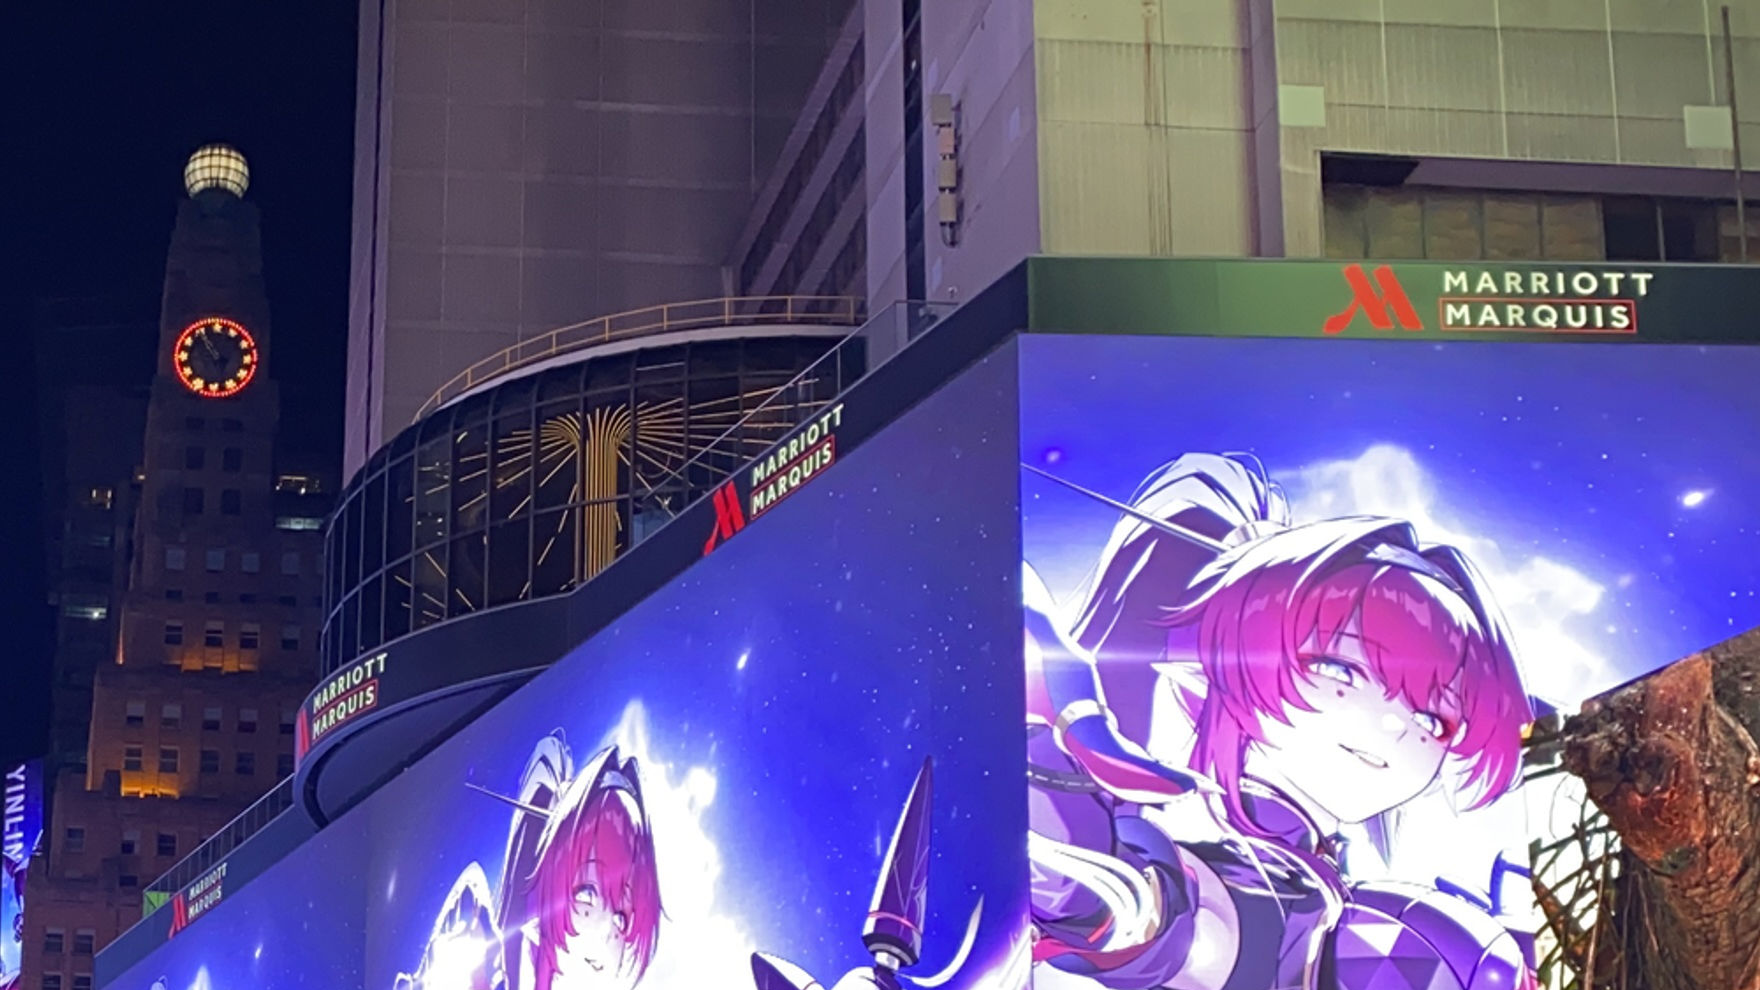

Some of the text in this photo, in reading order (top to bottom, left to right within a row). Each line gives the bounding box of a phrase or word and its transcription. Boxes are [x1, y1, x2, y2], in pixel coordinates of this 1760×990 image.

[1444, 270, 1654, 297] MARRIOTT
[1445, 304, 1630, 329] MARQUIS
[752, 403, 844, 487] MARRIOTT
[752, 443, 832, 515] MARQUIS
[313, 652, 388, 714] MARRIOTT
[312, 686, 374, 740] MARQUIS
